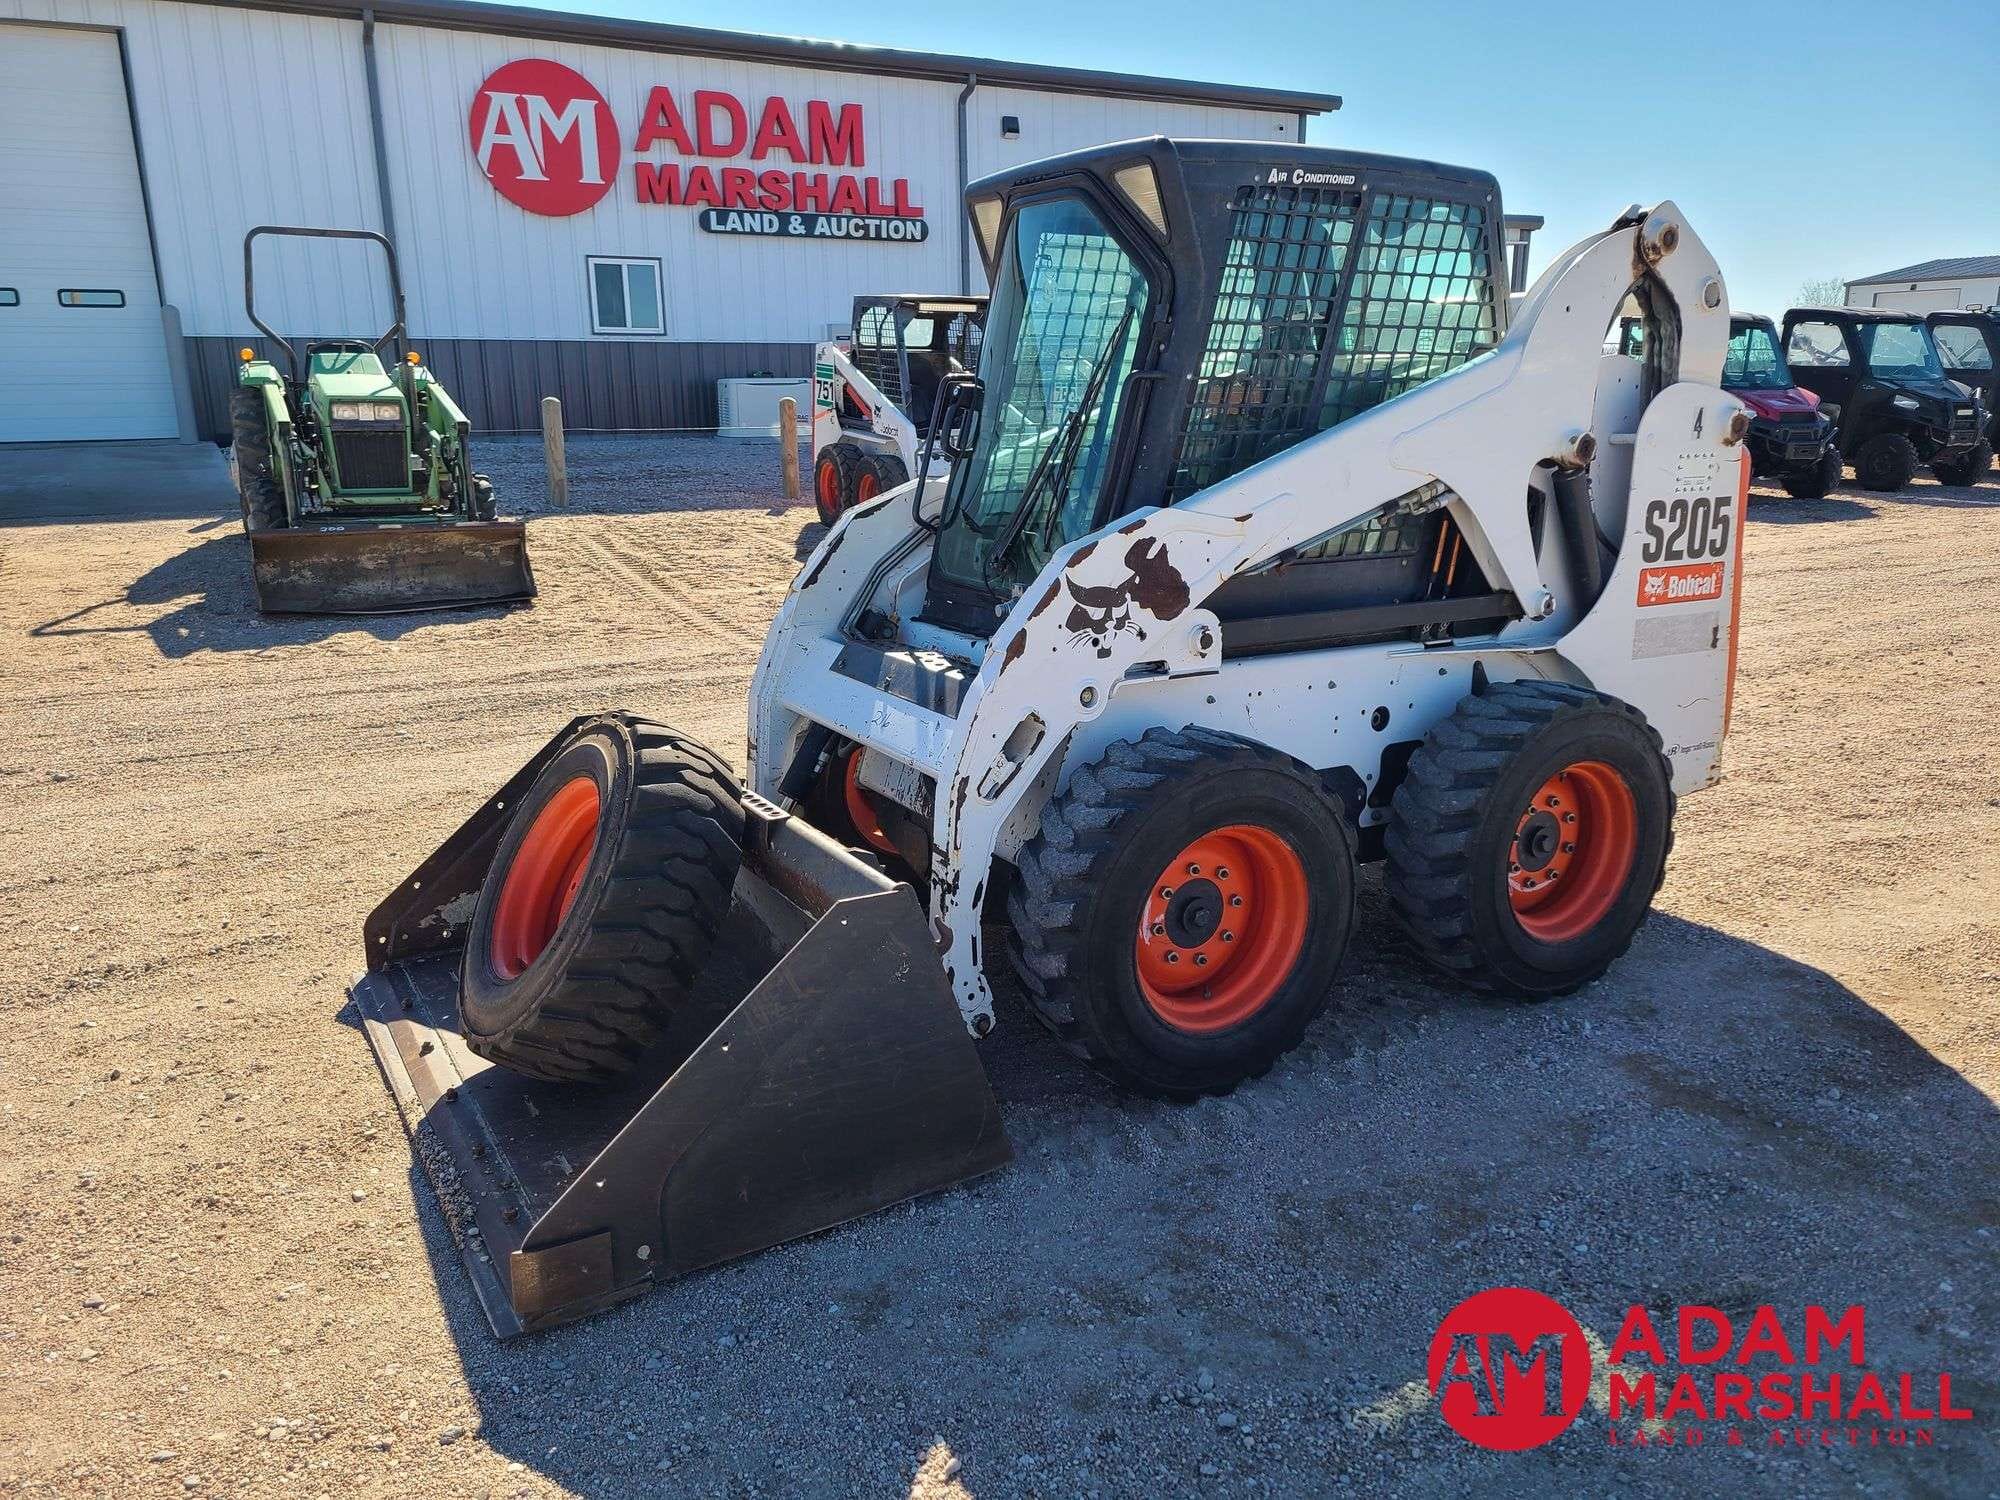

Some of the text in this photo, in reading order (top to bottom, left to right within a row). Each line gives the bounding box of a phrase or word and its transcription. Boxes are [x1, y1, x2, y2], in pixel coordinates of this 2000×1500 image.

[474, 91, 606, 185] AM
[633, 85, 865, 167] ADAM
[635, 162, 924, 217] MARSHALL
[709, 210, 923, 241] LAND & AUCTION
[816, 380, 834, 402] 751
[1693, 406, 1704, 440] 4
[1642, 496, 1732, 563] S205
[1667, 573, 1718, 599] Bobcat
